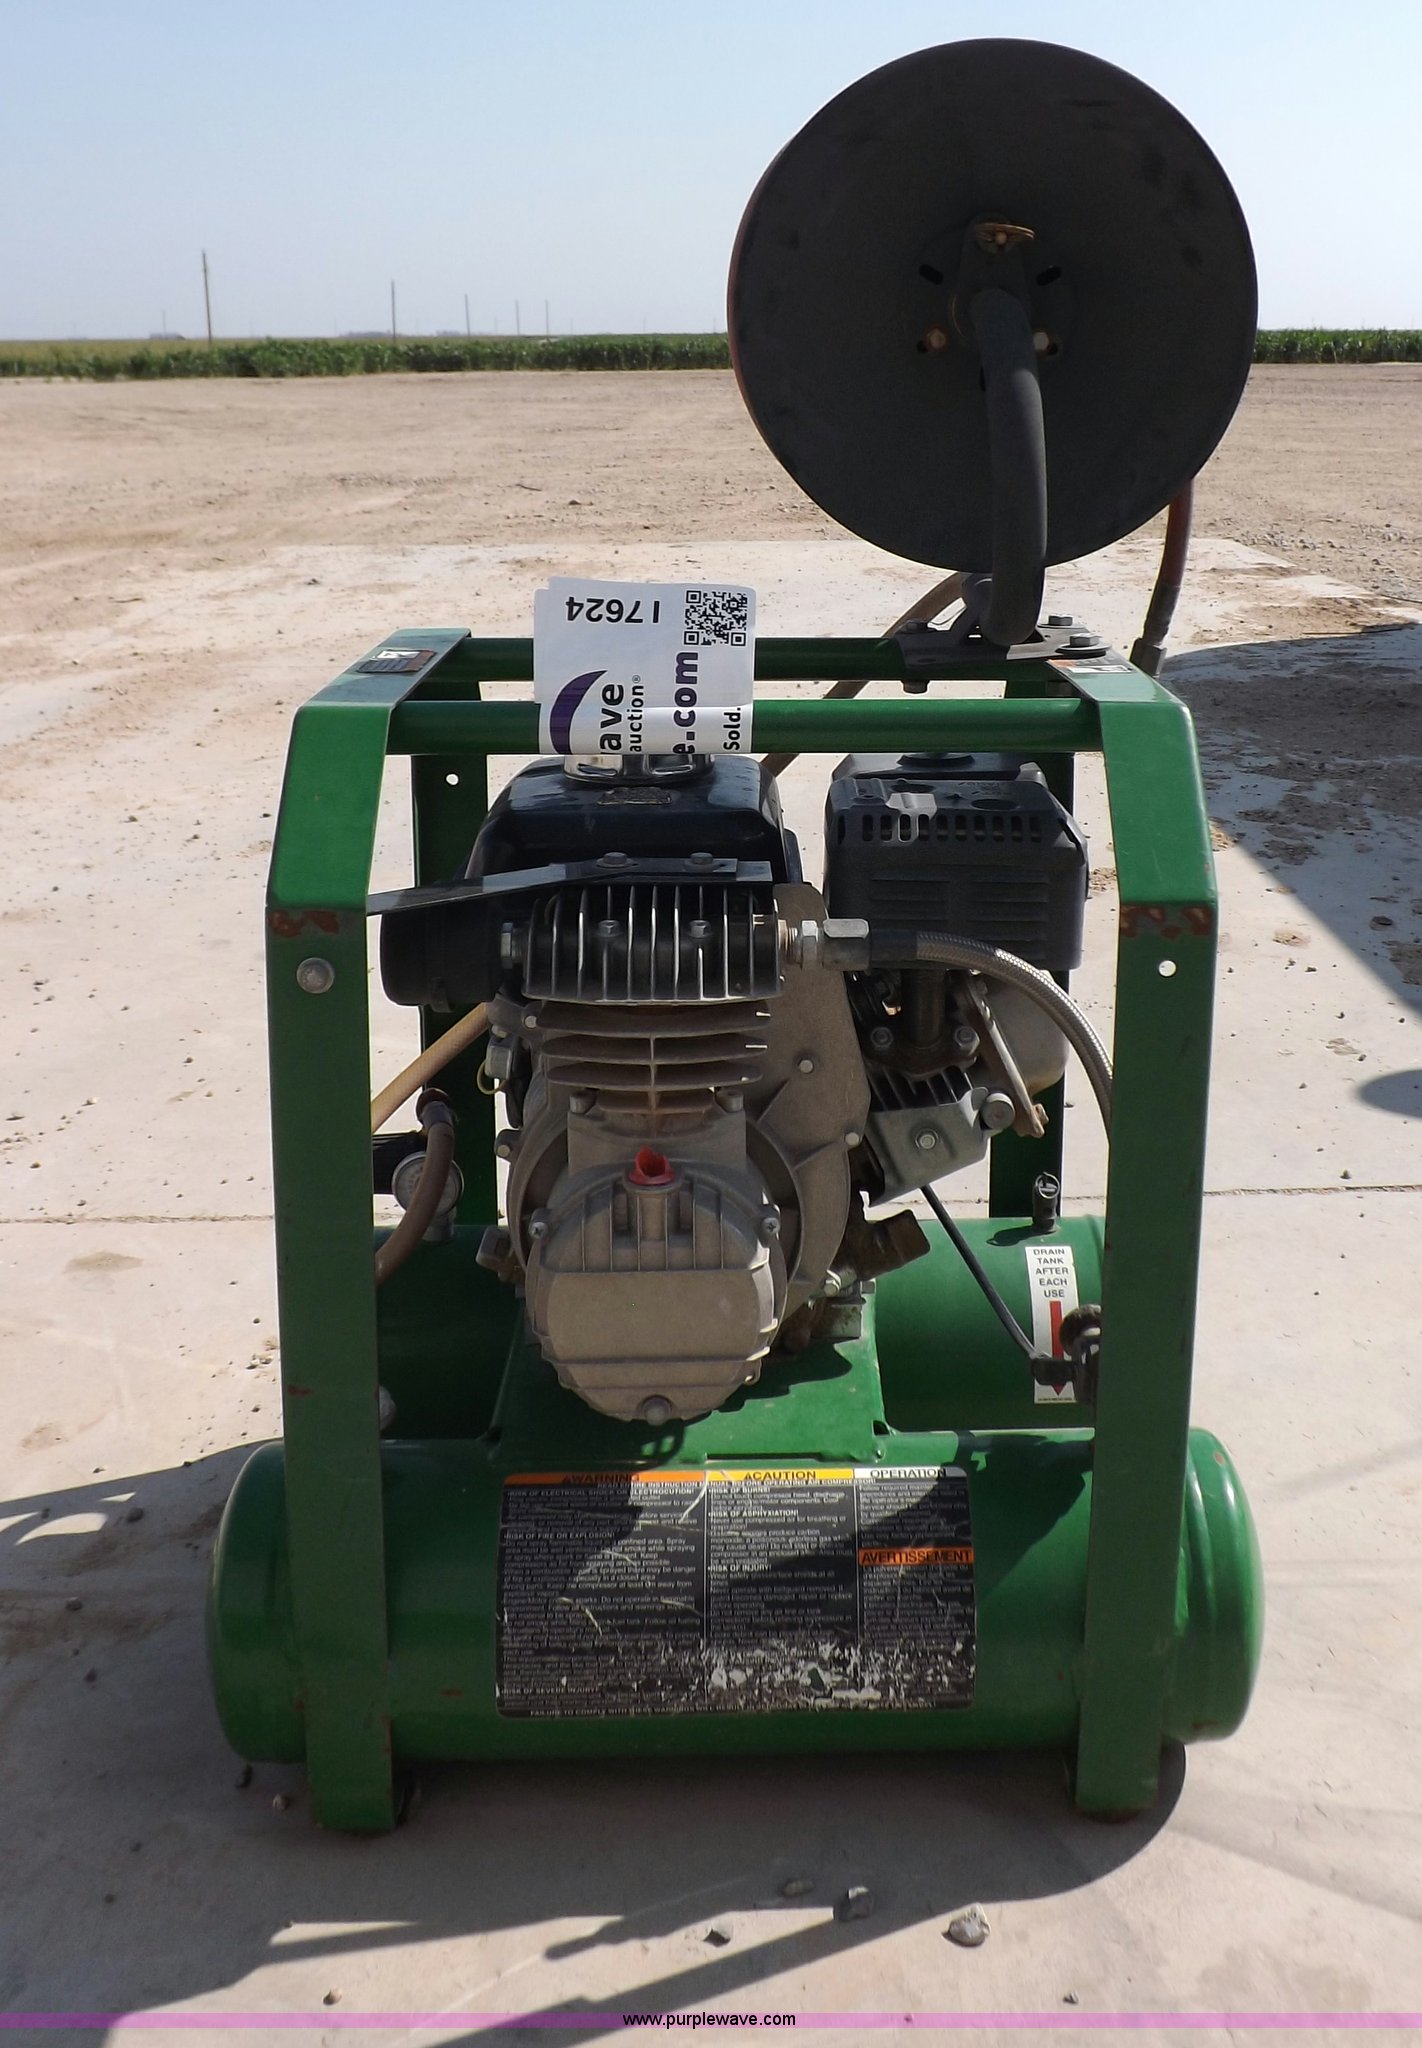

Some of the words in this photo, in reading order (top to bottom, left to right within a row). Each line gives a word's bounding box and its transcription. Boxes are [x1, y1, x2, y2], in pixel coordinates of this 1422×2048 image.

[600, 683, 624, 754] ave
[723, 707, 741, 751] Sold.
[1036, 1267, 1069, 1275] AFTER
[1039, 1278, 1067, 1286] EACH
[1044, 1289, 1065, 1298] USE
[753, 1471, 816, 1480] CAUTION
[870, 1468, 947, 1478] OPERATION
[570, 1473, 640, 1484] WARNING
[862, 1550, 971, 1563] AVERTISSEMENT
